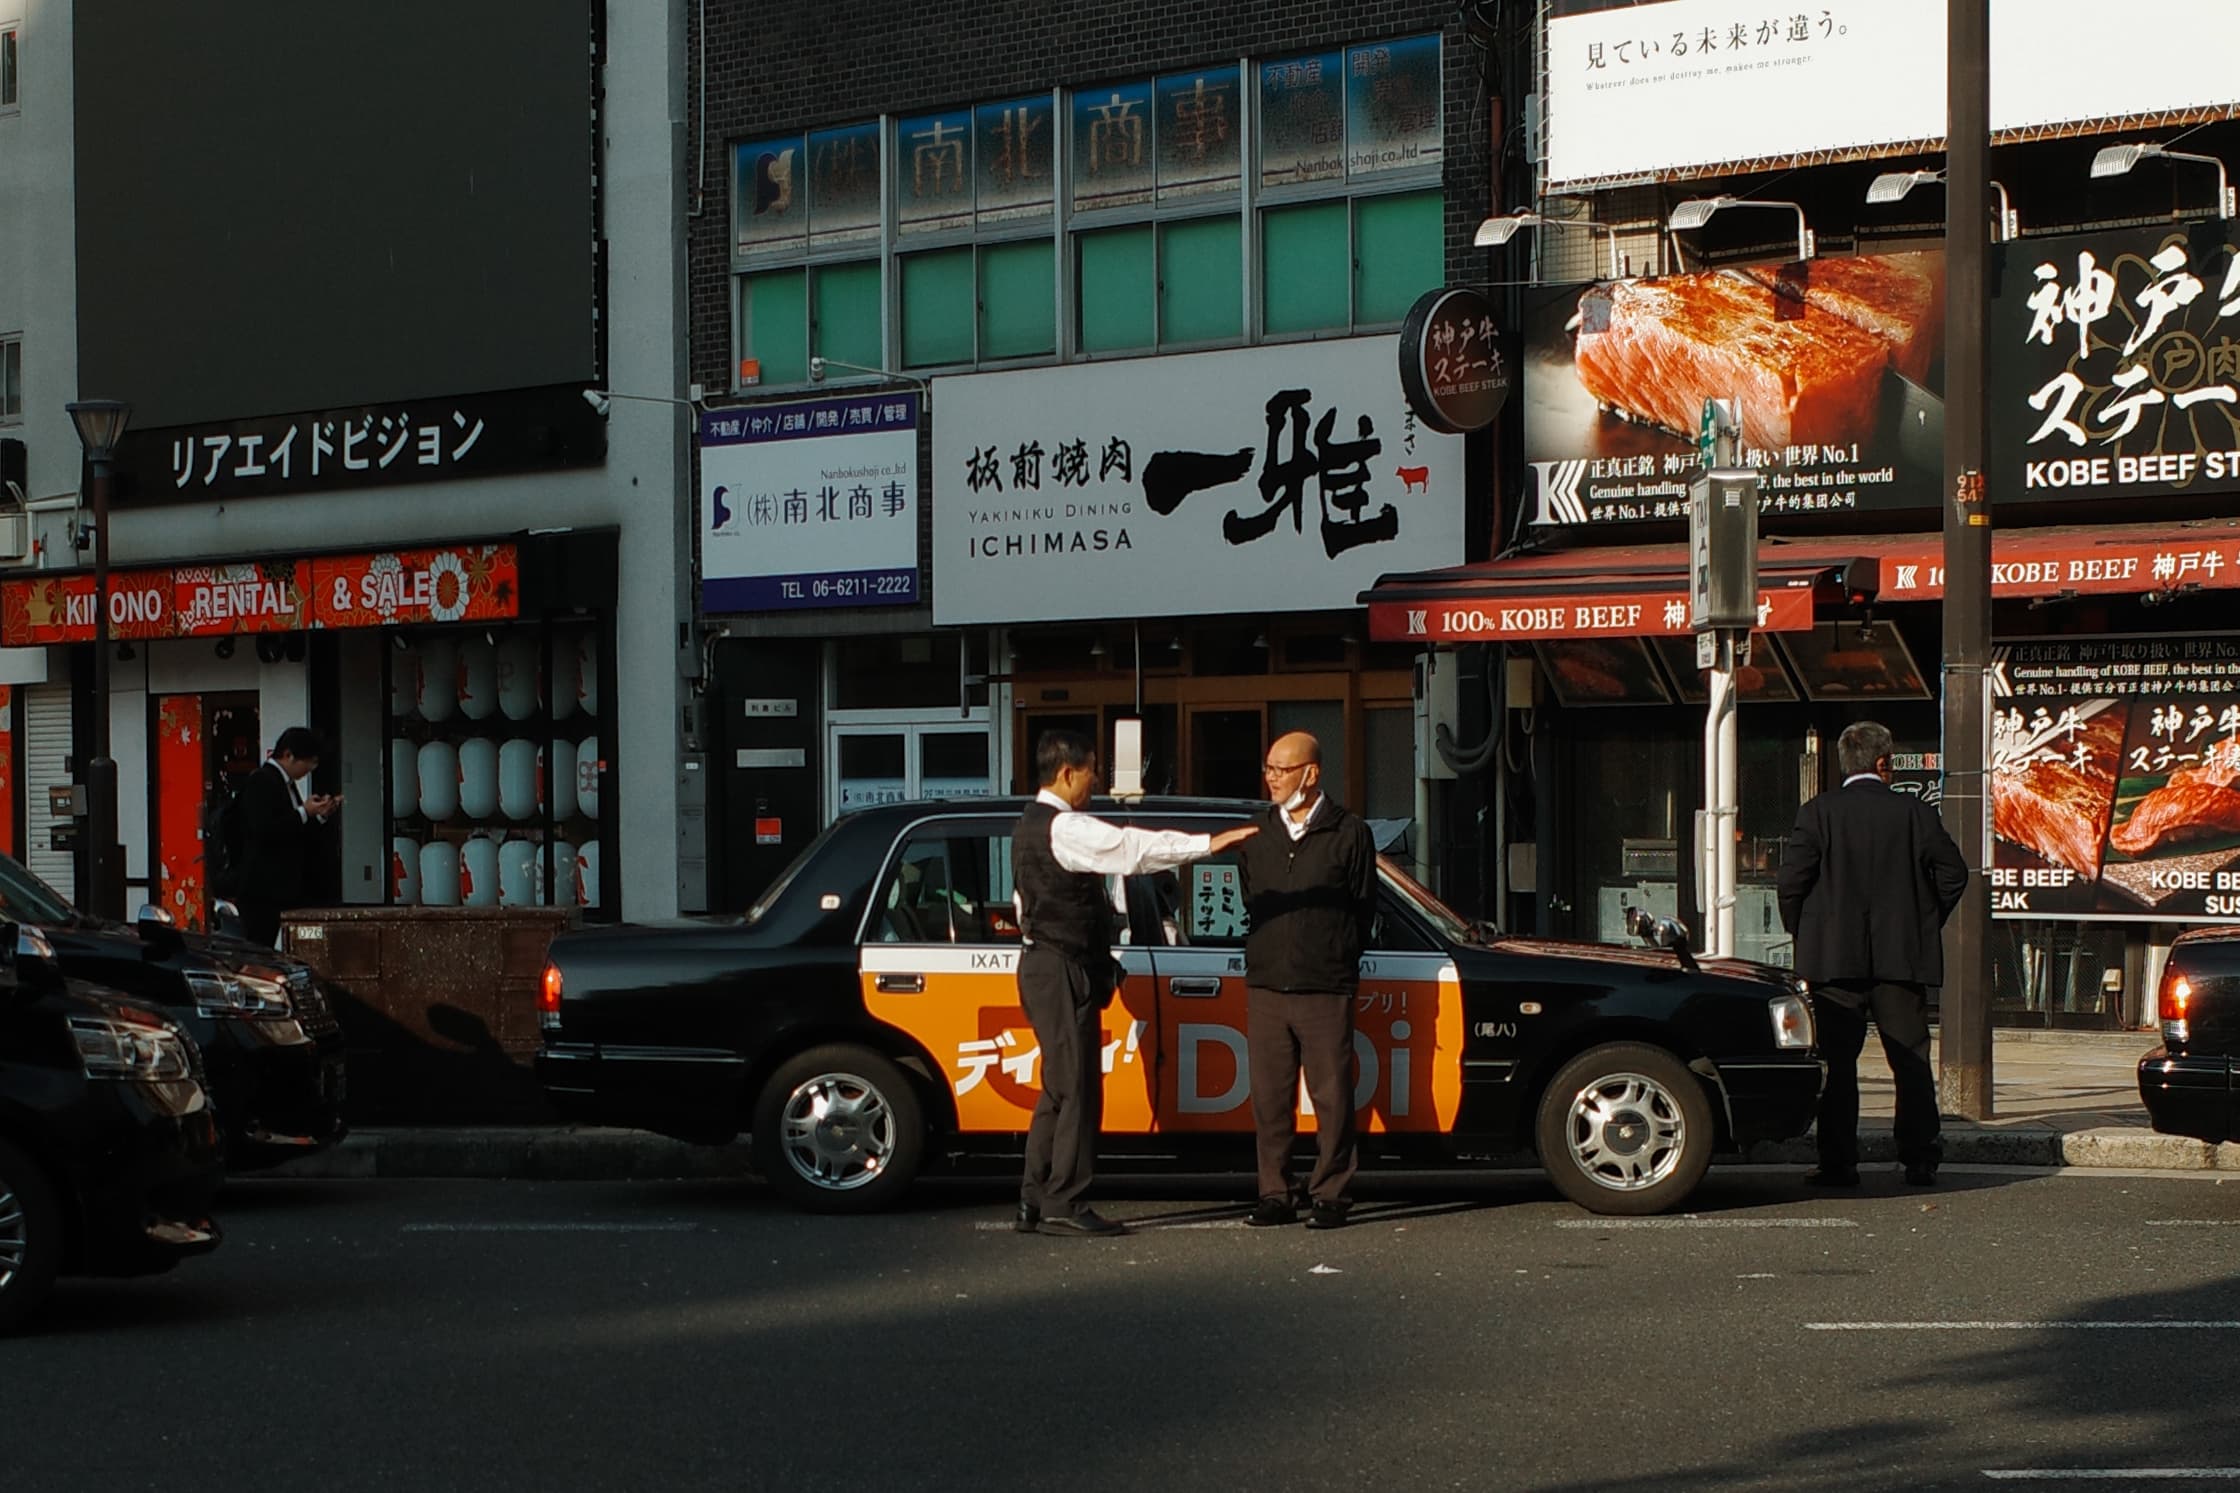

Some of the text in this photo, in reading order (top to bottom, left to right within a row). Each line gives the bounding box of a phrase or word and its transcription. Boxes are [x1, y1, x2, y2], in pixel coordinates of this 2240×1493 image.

[1585, 10, 1848, 71] 見ている未来が違う。
[1265, 59, 1323, 90] 不動産
[1352, 48, 1391, 76] 開発
[1296, 150, 1378, 175] Nanbokshoji
[1432, 316, 1499, 355] 神戸牛
[1434, 349, 1504, 384] ステーキ
[1434, 377, 1507, 396] KOBE BEEF STEAK
[172, 410, 485, 488] リアエイドビジョン
[1591, 455, 1656, 479] 正真正銘
[1785, 445, 1818, 467] 世界
[1822, 443, 1859, 464] No.1
[821, 466, 879, 480] Nanbokushoji
[965, 436, 1132, 493] 板前焼肉
[2026, 458, 2110, 489] KOBE
[2118, 454, 2197, 483] BEEF
[1590, 484, 1634, 500] Genuine
[1637, 481, 1686, 498] handling
[1773, 474, 1791, 489] the
[1794, 472, 1819, 487] best
[1822, 472, 1833, 486] in
[1836, 470, 1855, 485] the
[1858, 467, 1893, 484] world
[747, 480, 907, 526] (株)南北商事
[1591, 504, 1616, 520] 世界
[970, 528, 1133, 558] ICHIMASA
[1991, 562, 2059, 584] KOBE
[2068, 557, 2138, 581] BEEF
[2152, 551, 2225, 581] 神戸牛
[195, 580, 295, 619] RENTAL
[332, 576, 353, 611] &
[360, 570, 430, 609] SALE
[781, 576, 910, 599] TEL 06-6211-2222
[1441, 610, 1495, 632] 100%
[1500, 607, 1565, 630] KOBE
[1574, 605, 1641, 628] BEEF
[2015, 645, 2071, 662] 正真正銘
[2079, 643, 2179, 661] 神戸牛取り扱い
[2184, 641, 2213, 658] 世界
[2014, 666, 2053, 679] Genuine
[2056, 664, 2098, 679] handling
[2100, 664, 2111, 676] of
[2113, 664, 2140, 677] KOBE
[2143, 663, 2171, 677] BEEF,
[2173, 663, 2190, 675] the
[2192, 662, 2213, 675] best
[2215, 662, 2225, 675] in
[2015, 683, 2037, 696] 世界
[2151, 704, 2240, 743] 神戸牛
[1891, 753, 1923, 771] OBE
[1992, 869, 2075, 887] BE BEEF
[2151, 870, 2211, 890] KOBE
[1474, 1022, 1517, 1038] (尾八)
